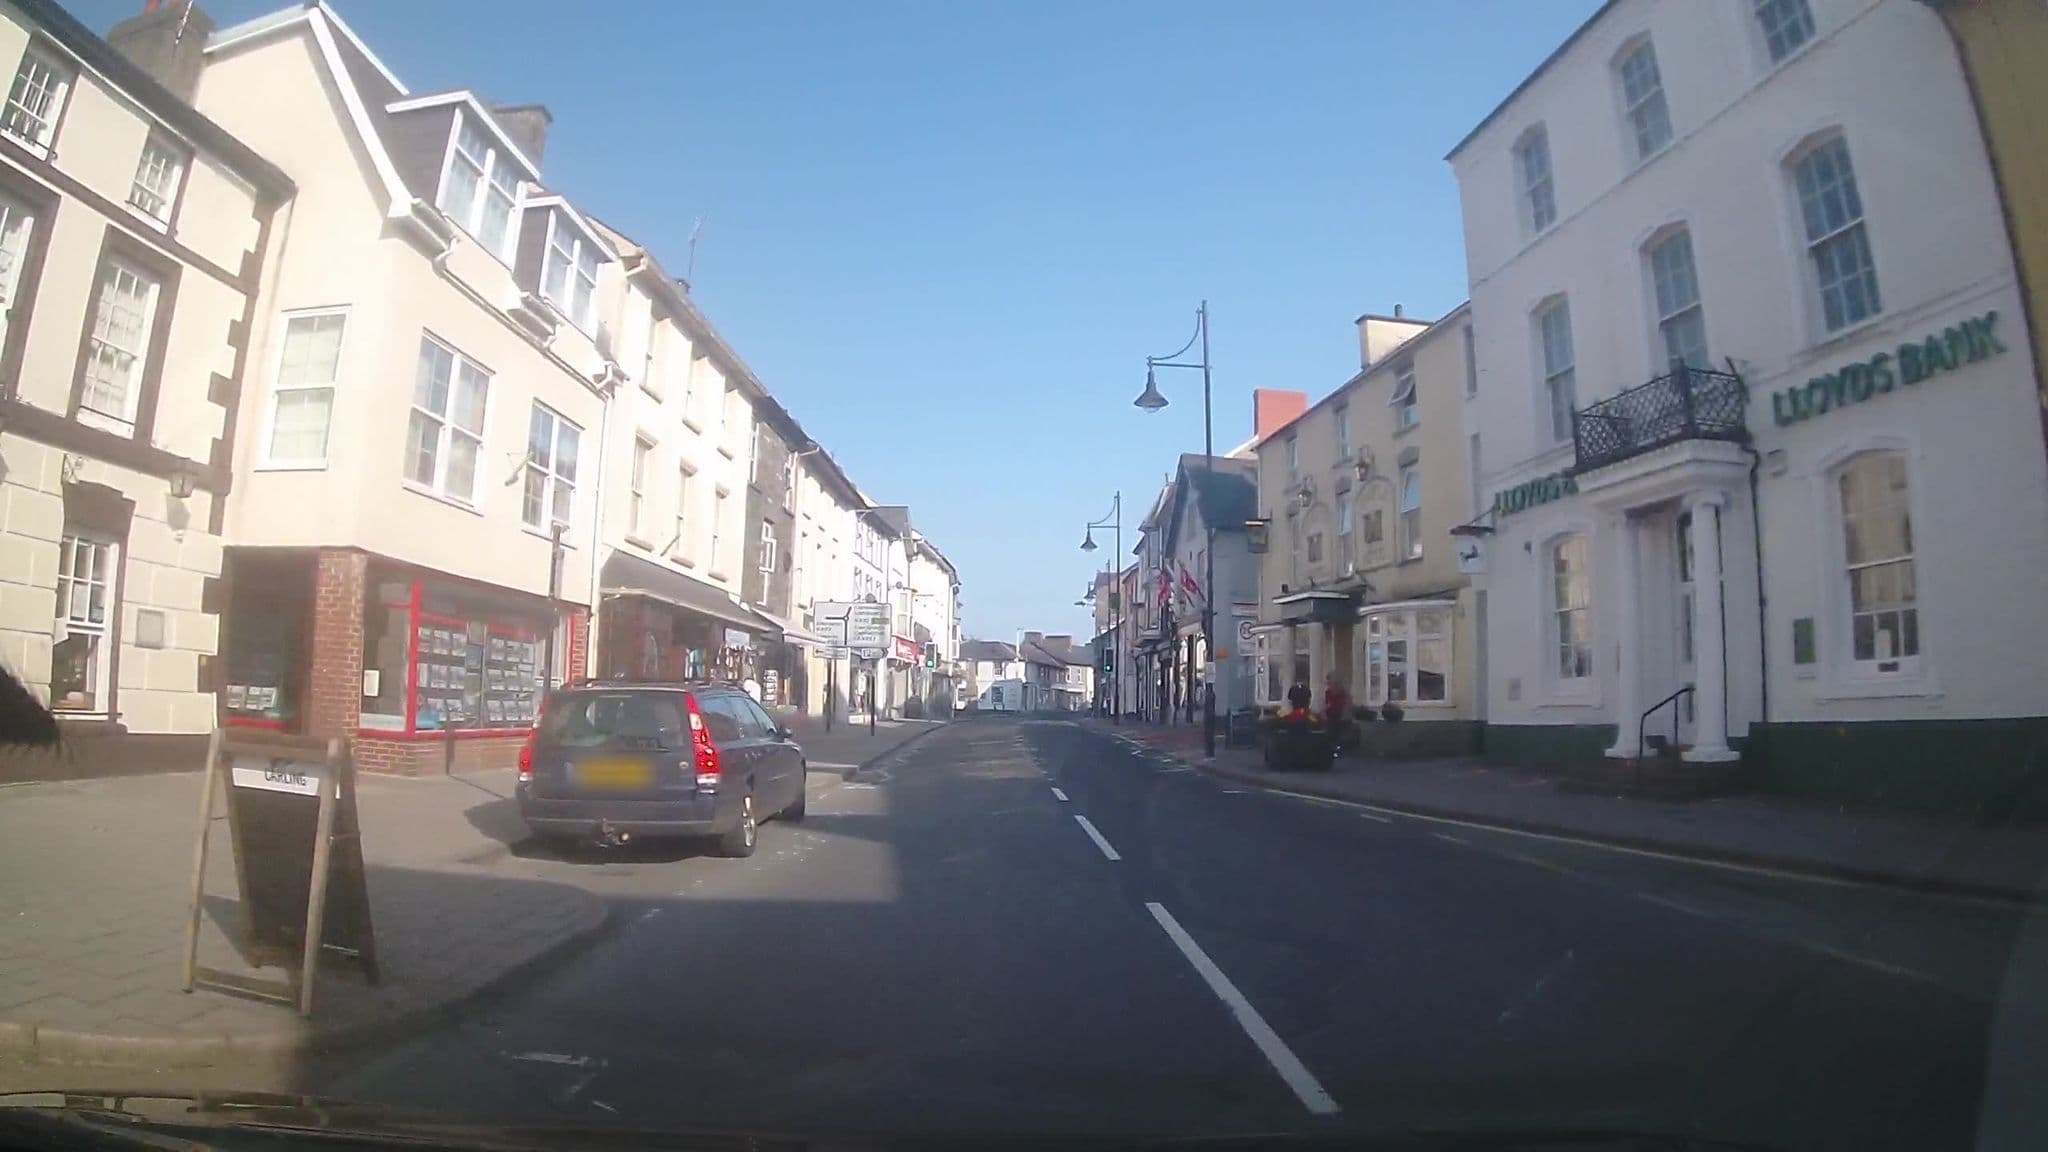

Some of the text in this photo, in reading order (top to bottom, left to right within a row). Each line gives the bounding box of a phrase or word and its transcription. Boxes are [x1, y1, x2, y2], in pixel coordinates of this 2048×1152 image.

[1773, 310, 2007, 427] LLOYDS BANK
[264, 768, 306, 786] CARLING
